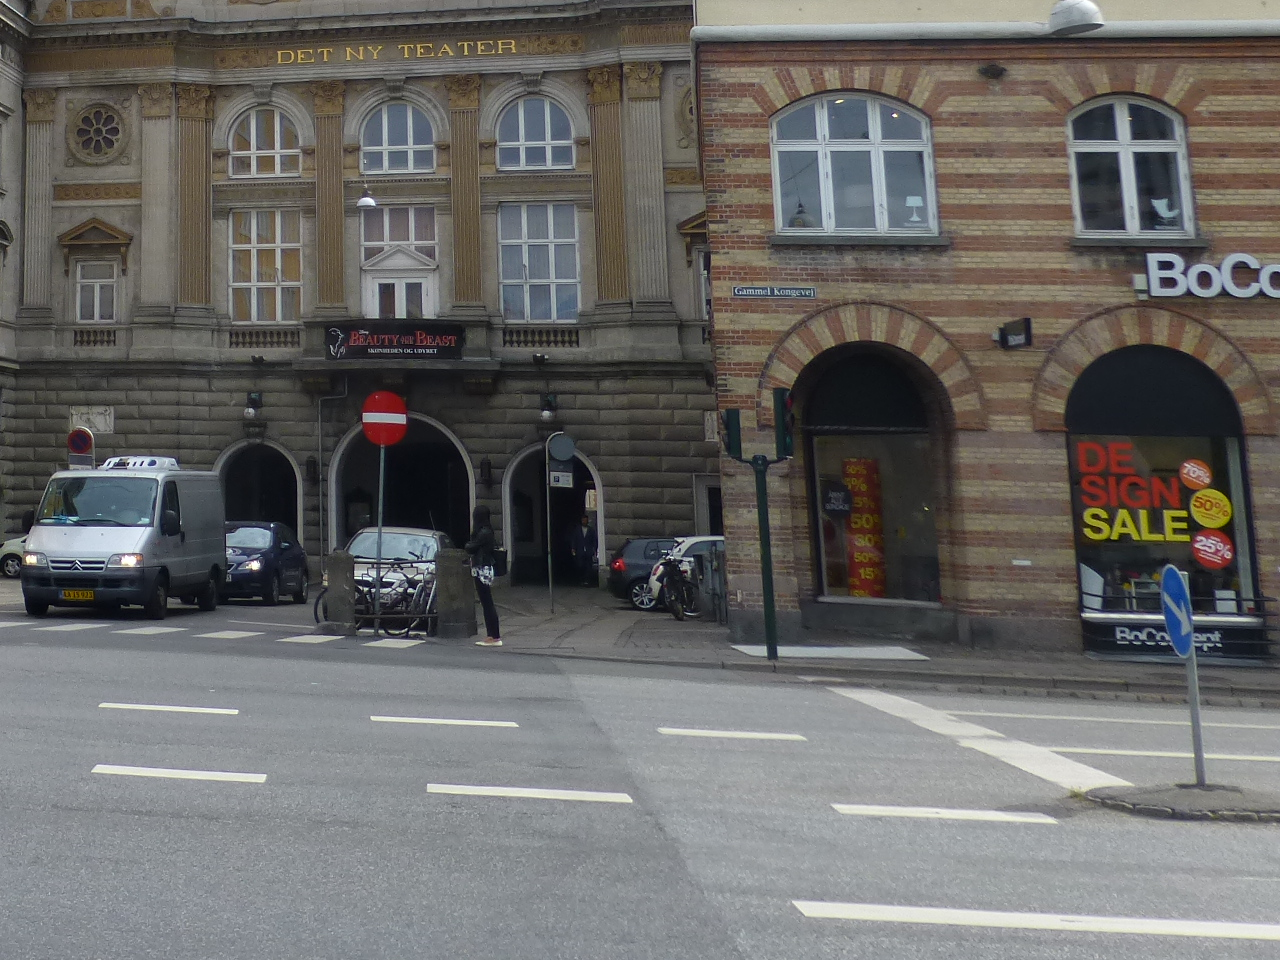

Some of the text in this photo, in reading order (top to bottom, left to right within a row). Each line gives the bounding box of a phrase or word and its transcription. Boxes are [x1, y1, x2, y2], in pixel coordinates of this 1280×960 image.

[276, 38, 517, 64] DET NY TEATER
[734, 286, 814, 297] Gammel Kongevej
[415, 330, 457, 347] BEAST
[1077, 441, 1136, 475] DE
[1183, 462, 1211, 484] 70%
[1080, 475, 1182, 509] SIGN
[1192, 496, 1230, 517] 50%
[1083, 507, 1191, 542] SALE
[1194, 535, 1232, 559] 25%
[1115, 626, 1223, 651] BoCoept
